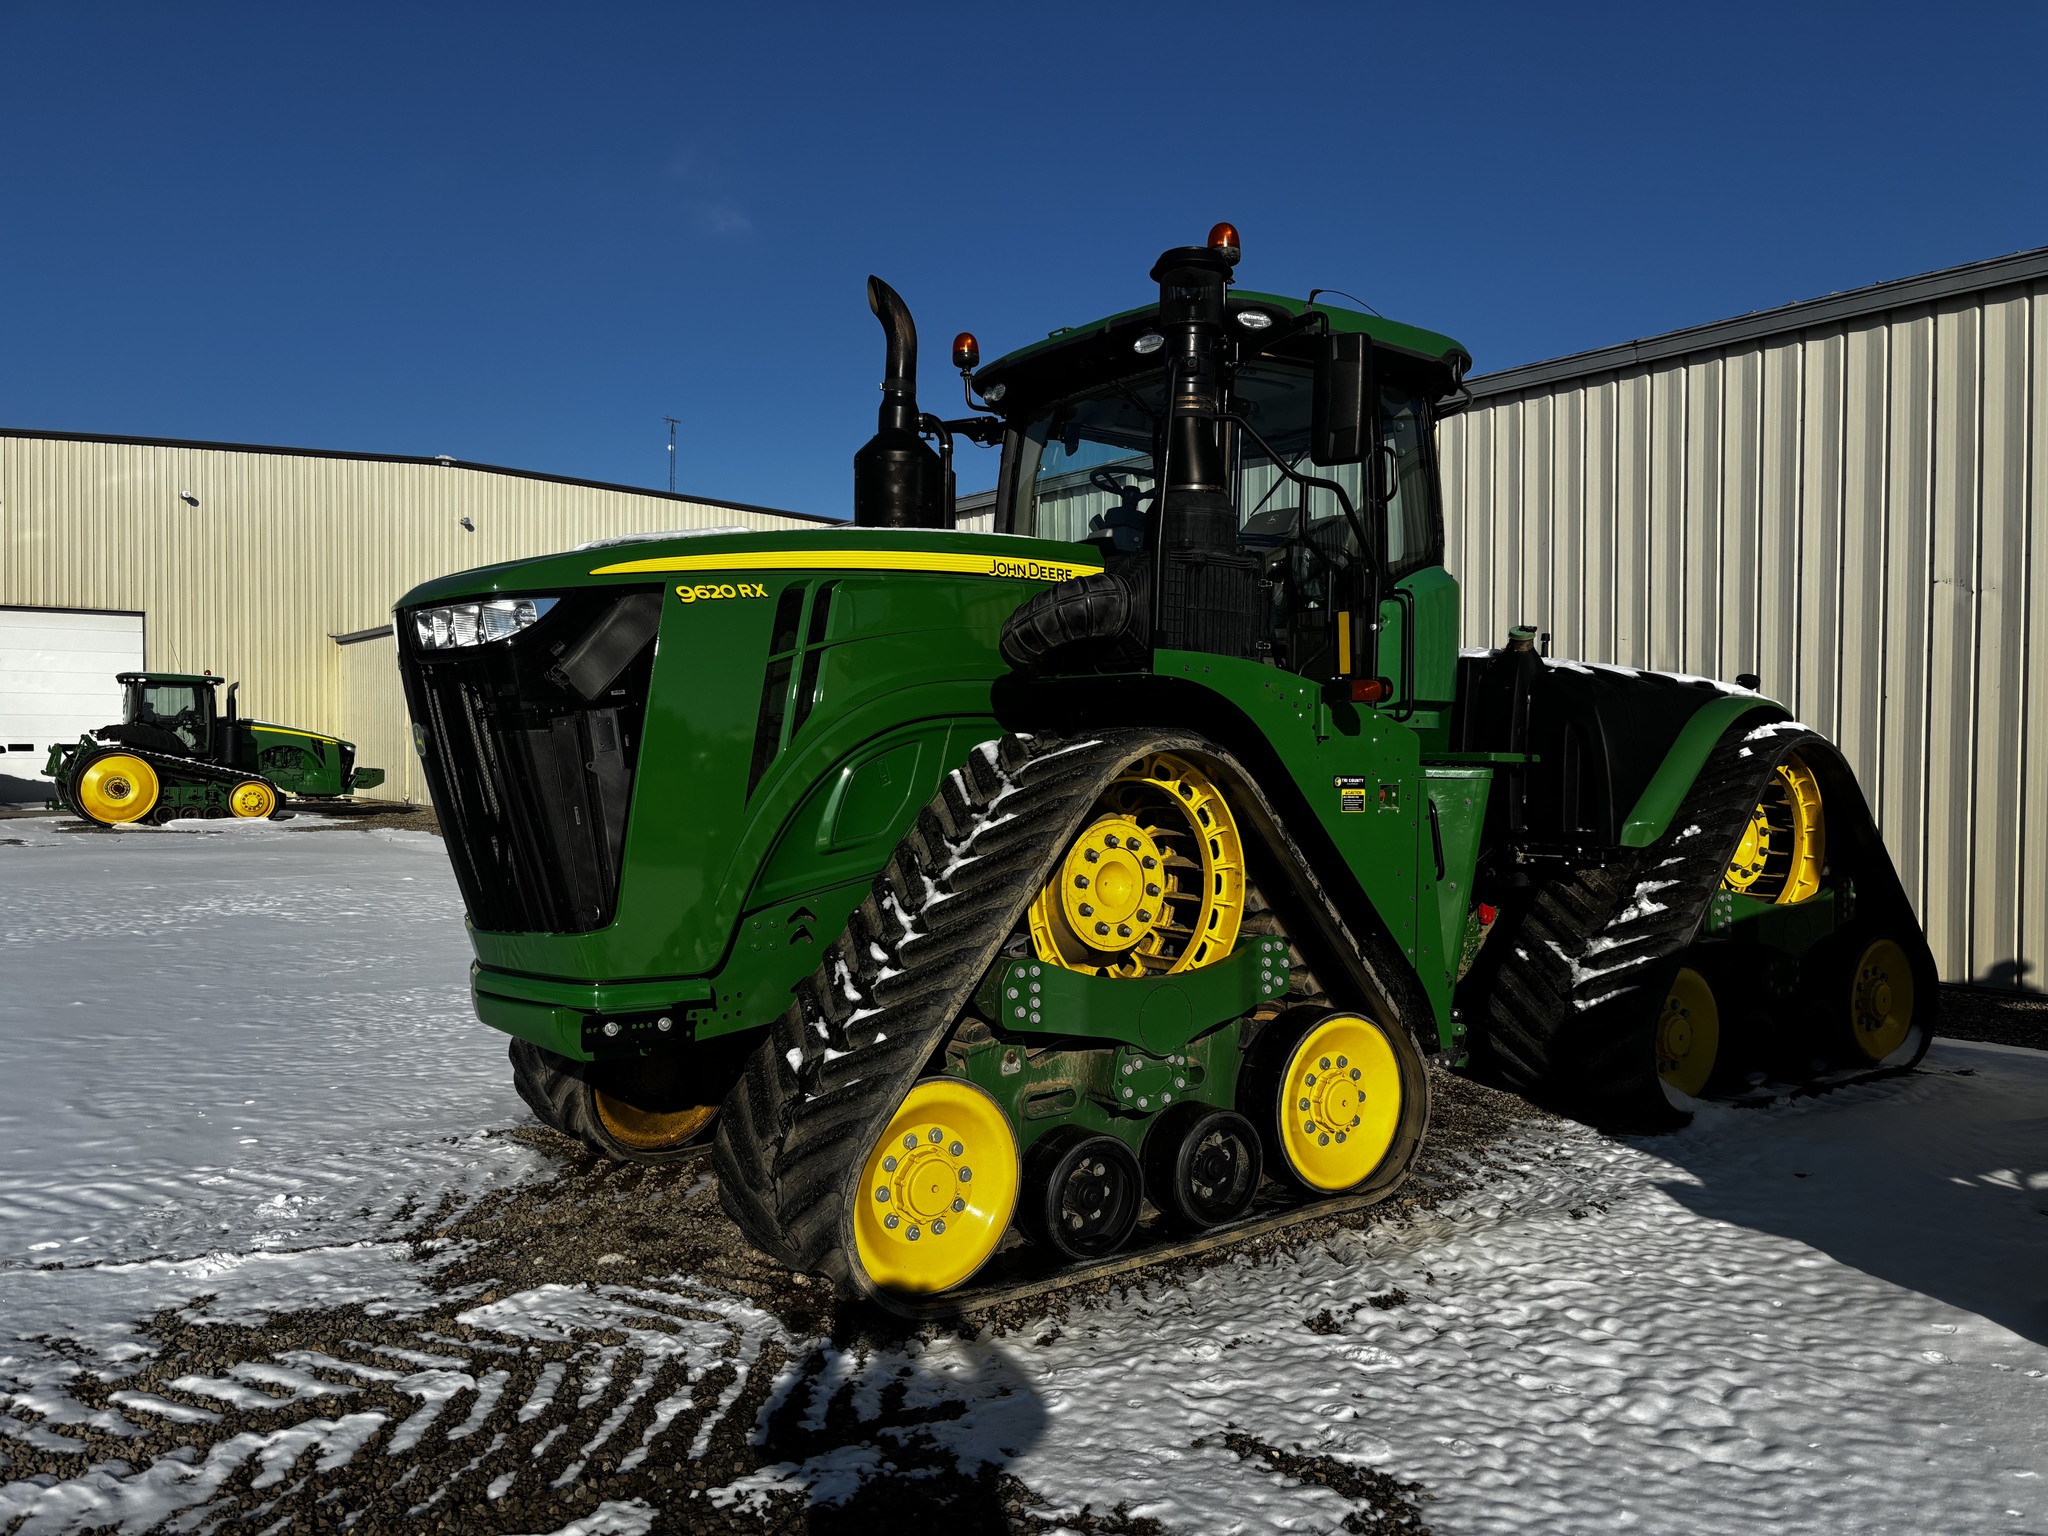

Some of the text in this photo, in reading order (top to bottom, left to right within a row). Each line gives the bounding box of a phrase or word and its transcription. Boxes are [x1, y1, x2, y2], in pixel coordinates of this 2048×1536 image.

[989, 559, 1073, 581] JOHN DEERE
[675, 583, 769, 603] 9620 RX
